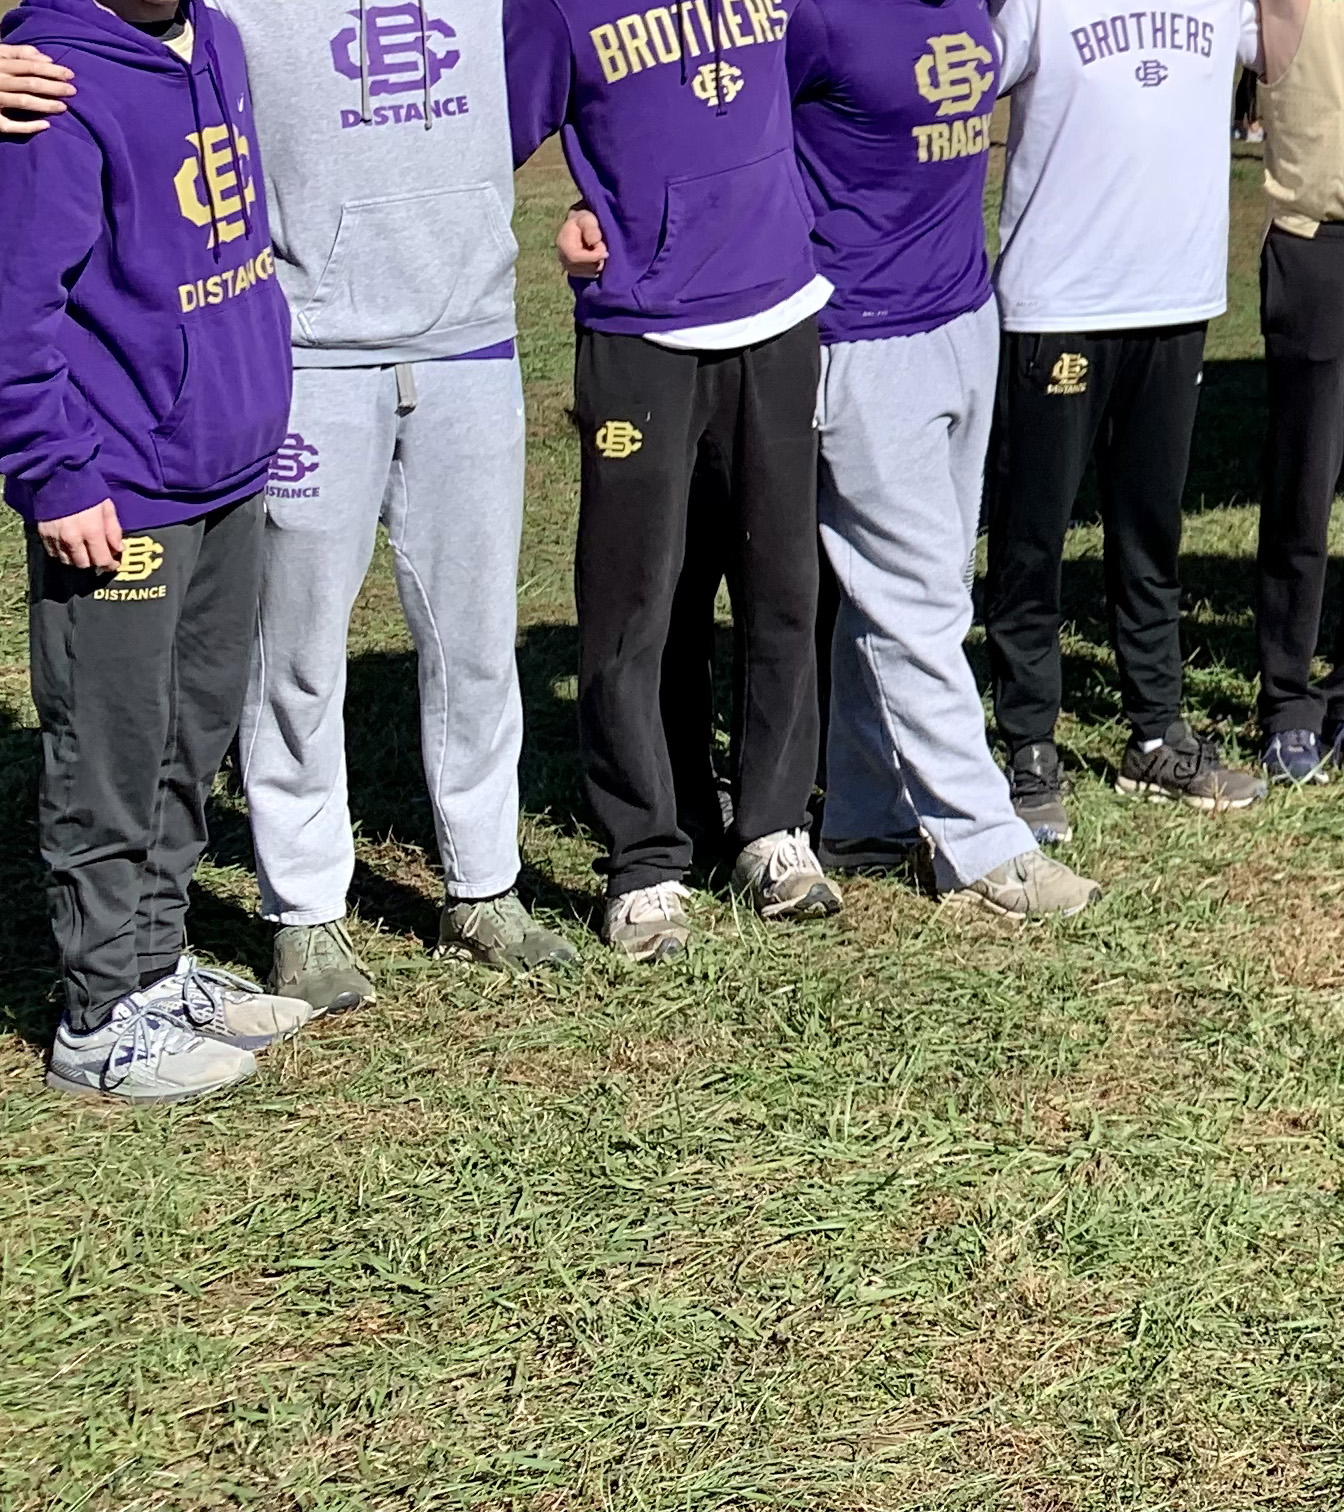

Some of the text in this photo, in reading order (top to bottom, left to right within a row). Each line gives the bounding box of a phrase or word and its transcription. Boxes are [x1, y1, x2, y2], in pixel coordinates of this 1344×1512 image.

[1070, 11, 1214, 66] BROTHERS
[340, 95, 470, 128] DSTANCE
[178, 245, 275, 313] DISTANCE
[265, 485, 320, 499] ISTANCE
[93, 585, 167, 601] DISTANCE
